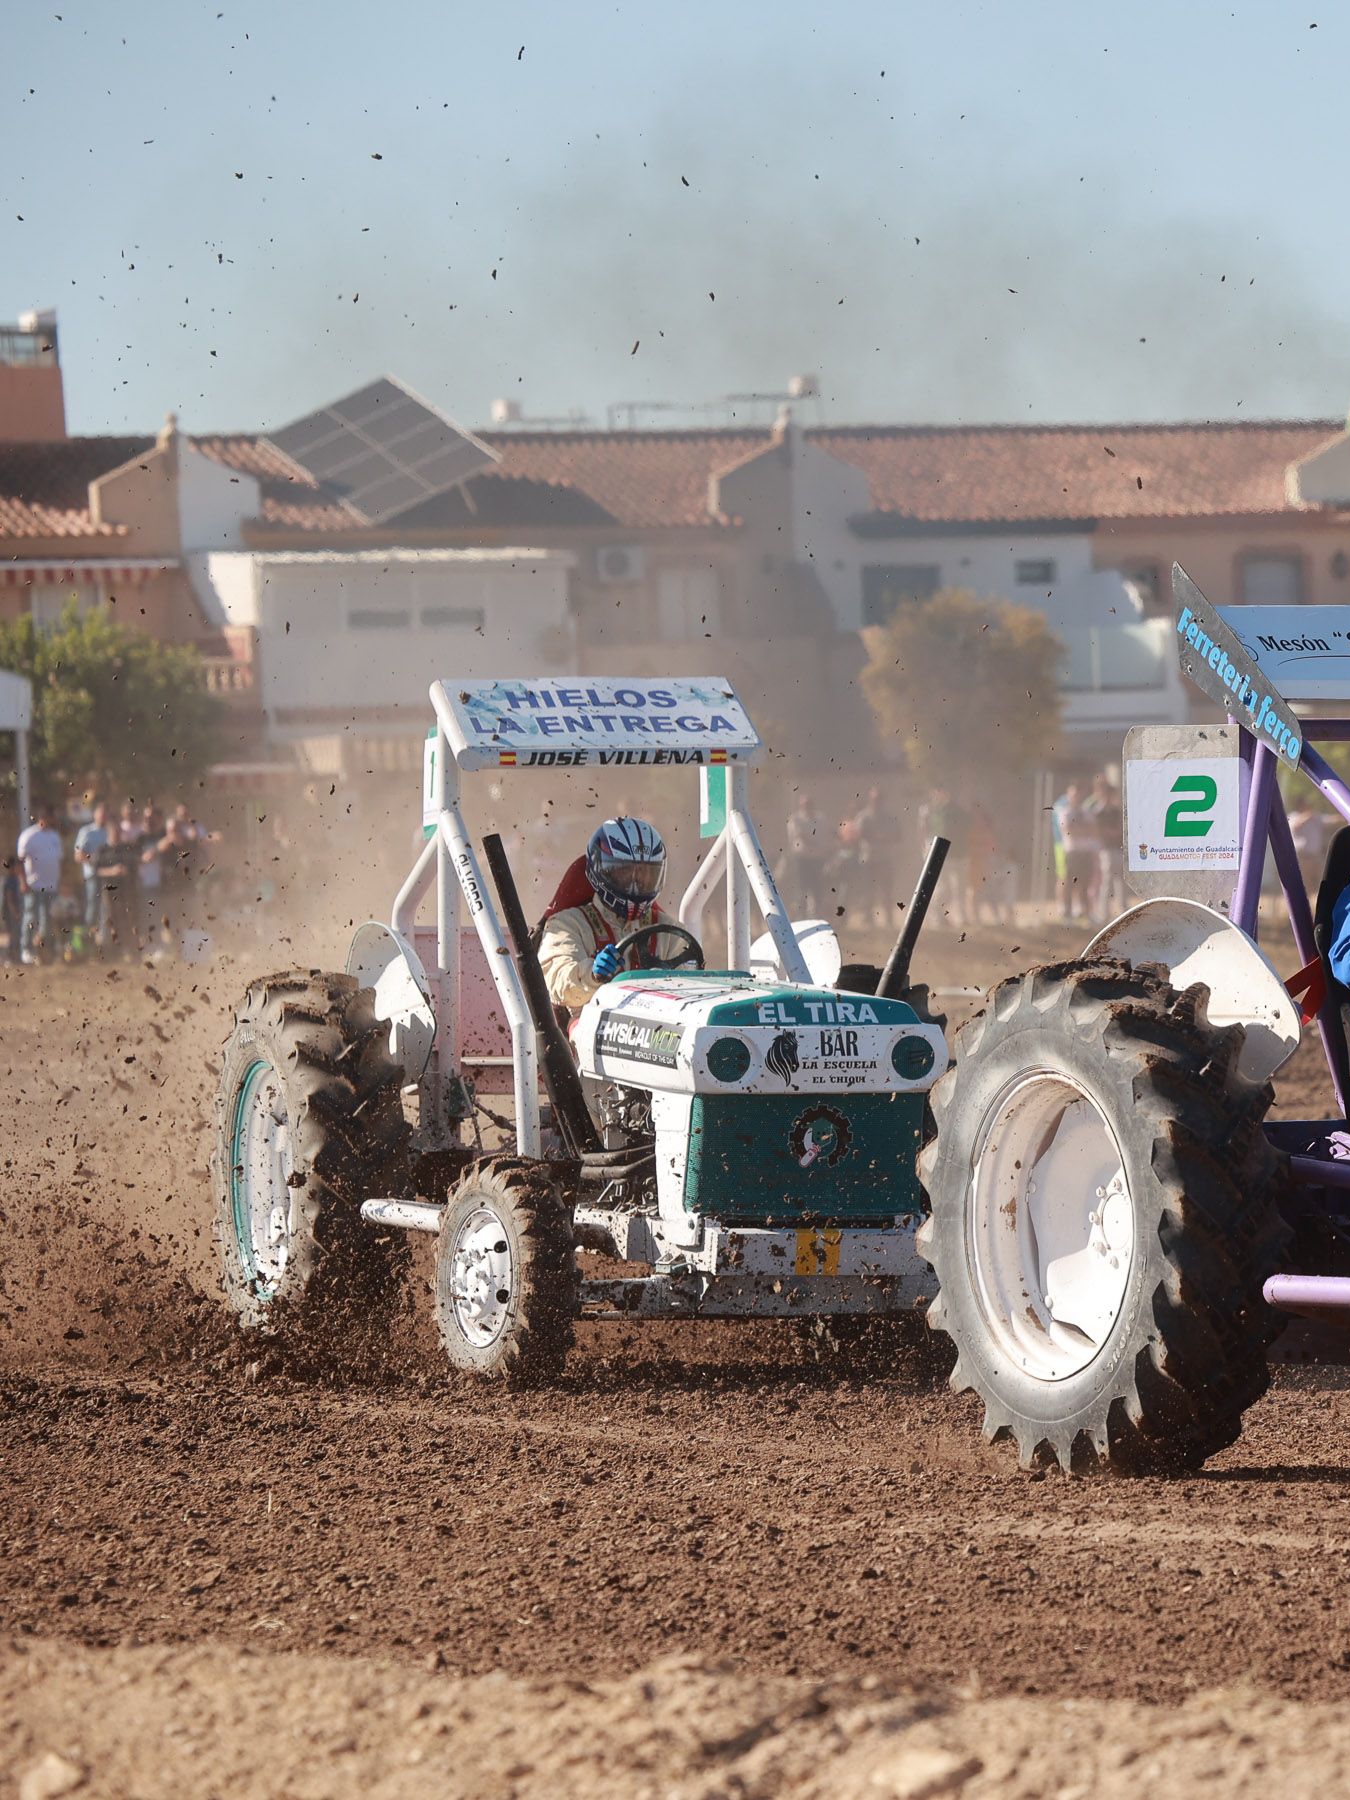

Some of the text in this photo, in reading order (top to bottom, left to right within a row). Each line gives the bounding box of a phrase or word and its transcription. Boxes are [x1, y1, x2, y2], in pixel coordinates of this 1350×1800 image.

[1257, 635, 1331, 651] Mesón
[1177, 607, 1258, 713] Ferreteria
[505, 688, 678, 709] HIELOS
[469, 714, 737, 734] LA ENTREGA
[598, 749, 704, 766] VILLENA
[1164, 775, 1217, 837] 2
[1150, 846, 1195, 854] Ayuntamiento
[758, 1002, 879, 1024] EL TIRA
[820, 1029, 859, 1057] BAR
[802, 1060, 878, 1070] LA ESCUELA
[812, 1076, 826, 1084] EL
